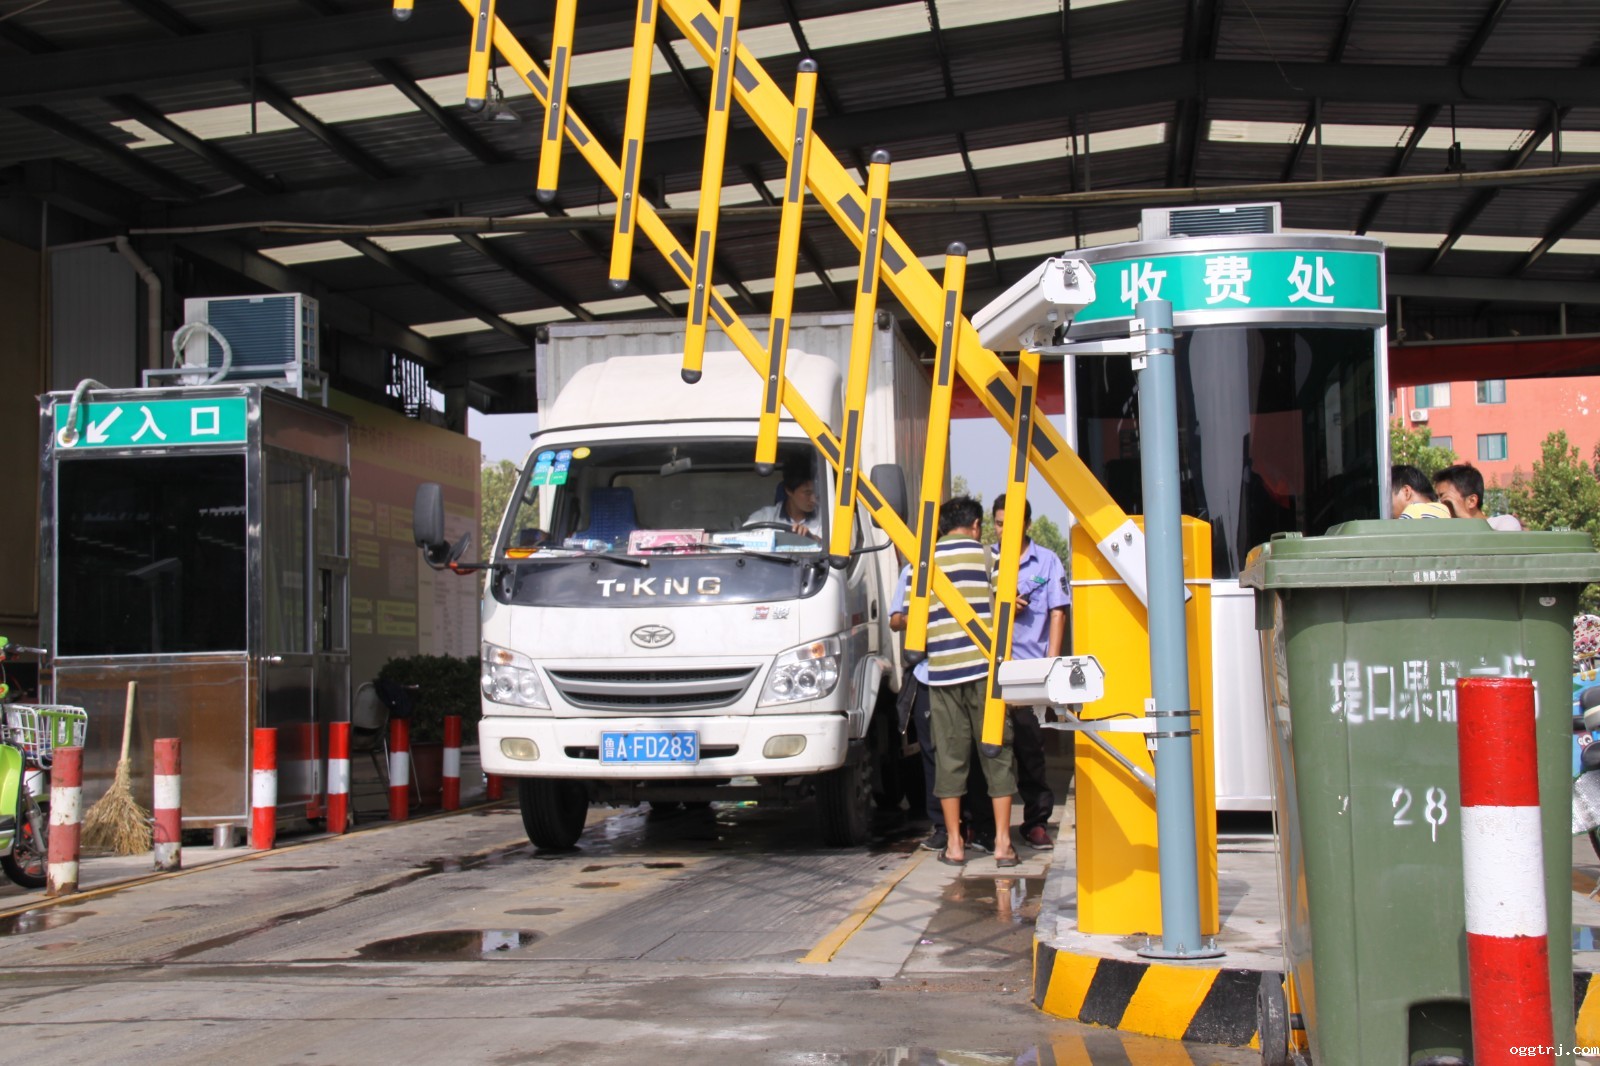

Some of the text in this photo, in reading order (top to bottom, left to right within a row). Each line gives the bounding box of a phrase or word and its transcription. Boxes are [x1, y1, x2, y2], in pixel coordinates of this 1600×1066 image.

[1119, 254, 1336, 310] 收费处
[131, 405, 220, 442] 入口
[1329, 655, 1541, 724] 堤口果品
[1391, 786, 1449, 828] 28
